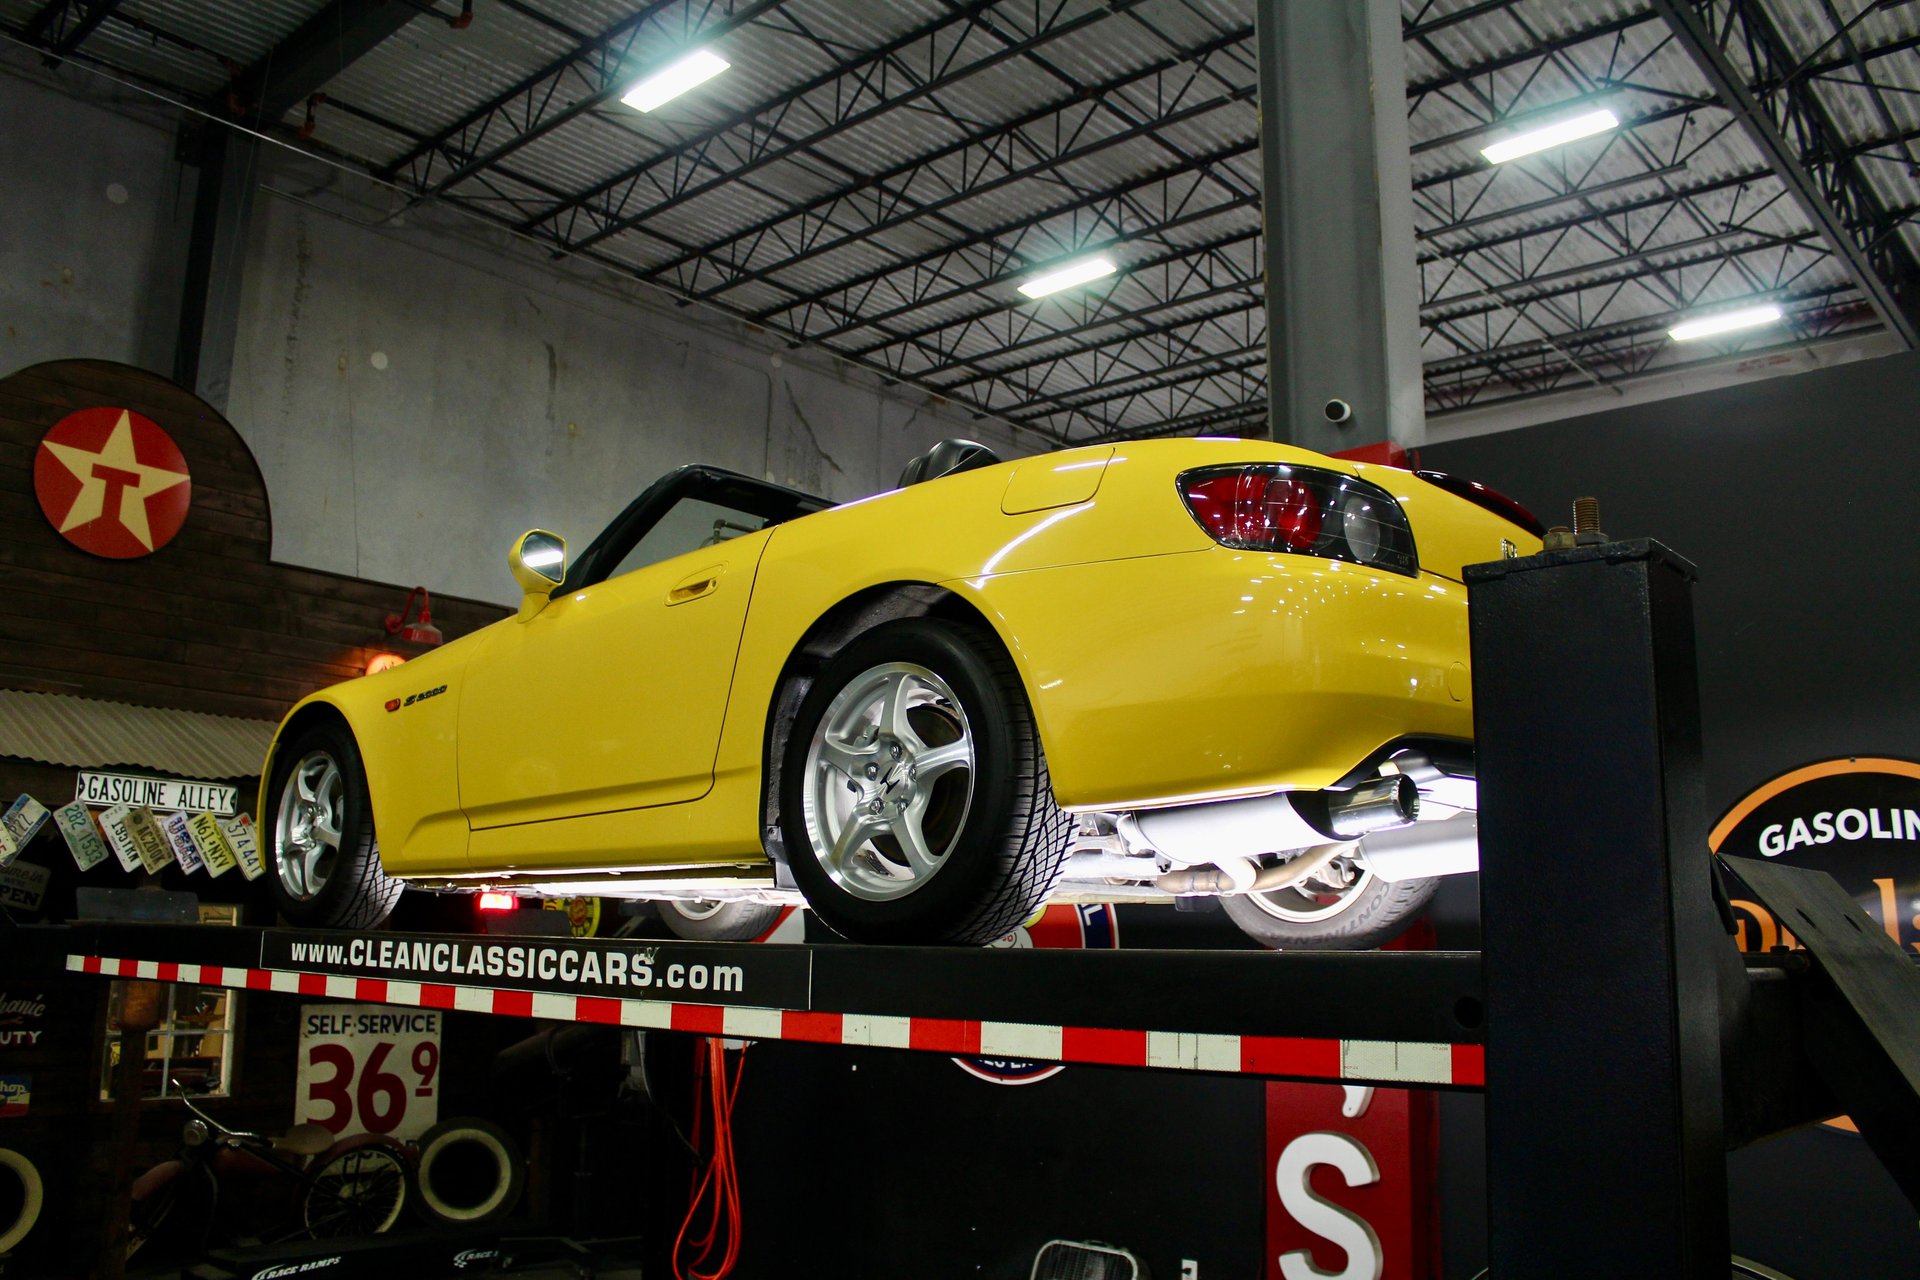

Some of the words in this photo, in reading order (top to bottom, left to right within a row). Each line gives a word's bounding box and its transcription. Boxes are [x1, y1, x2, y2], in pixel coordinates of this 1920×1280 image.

[88, 776, 167, 806] GASOLINE
[178, 785, 228, 811] ALLEY
[291, 939, 743, 992] www.CLEANCLASSICCARS.com
[299, 1257, 342, 1272] RAMPS
